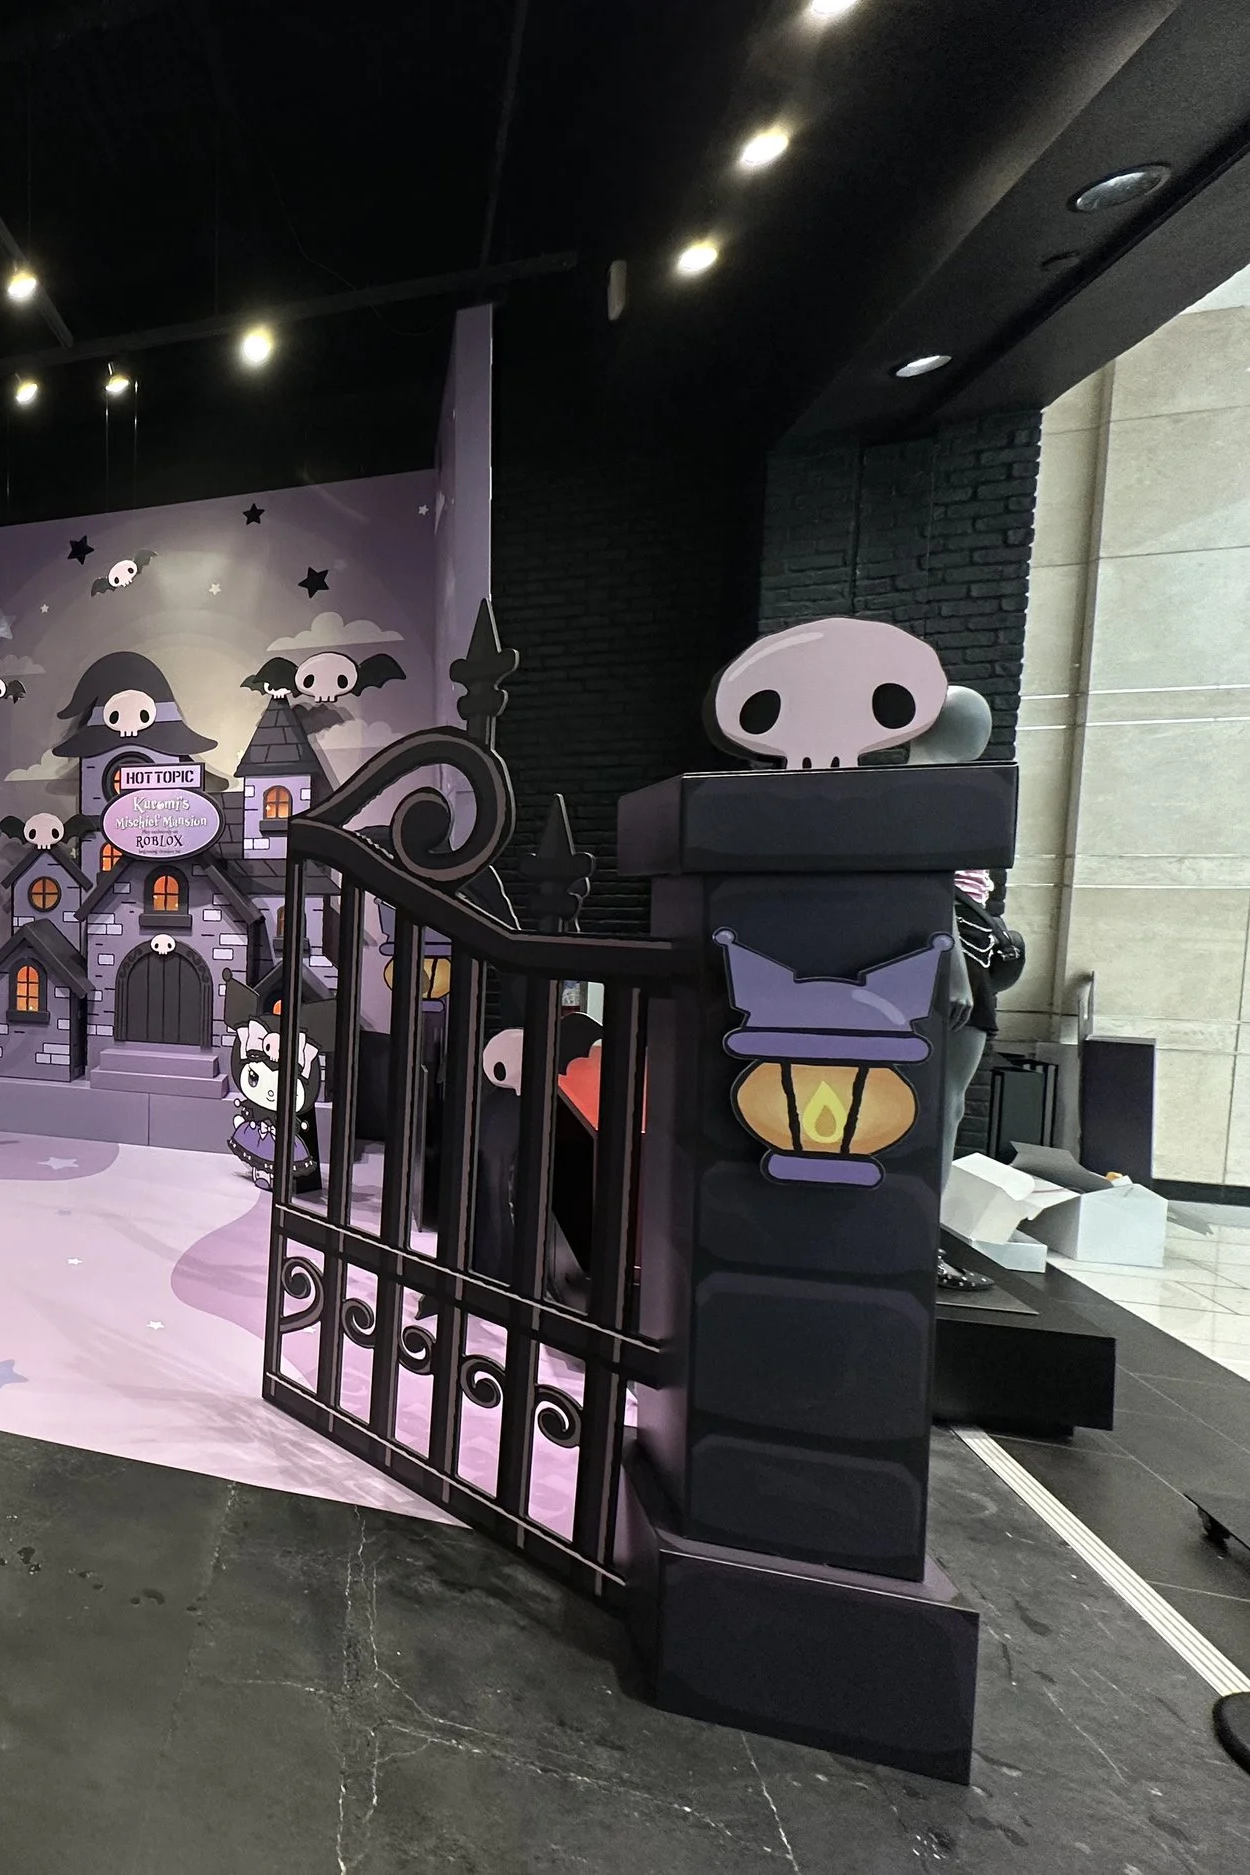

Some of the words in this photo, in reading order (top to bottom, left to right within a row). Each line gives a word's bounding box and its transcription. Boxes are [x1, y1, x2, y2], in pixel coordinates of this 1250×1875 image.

[126, 772, 152, 785] HOT
[154, 770, 194, 784] TOPIC
[133, 796, 190, 814] Kuromi's
[115, 814, 162, 830] Mischief
[162, 815, 208, 829] Mansion
[136, 835, 183, 848] ROBLOX
